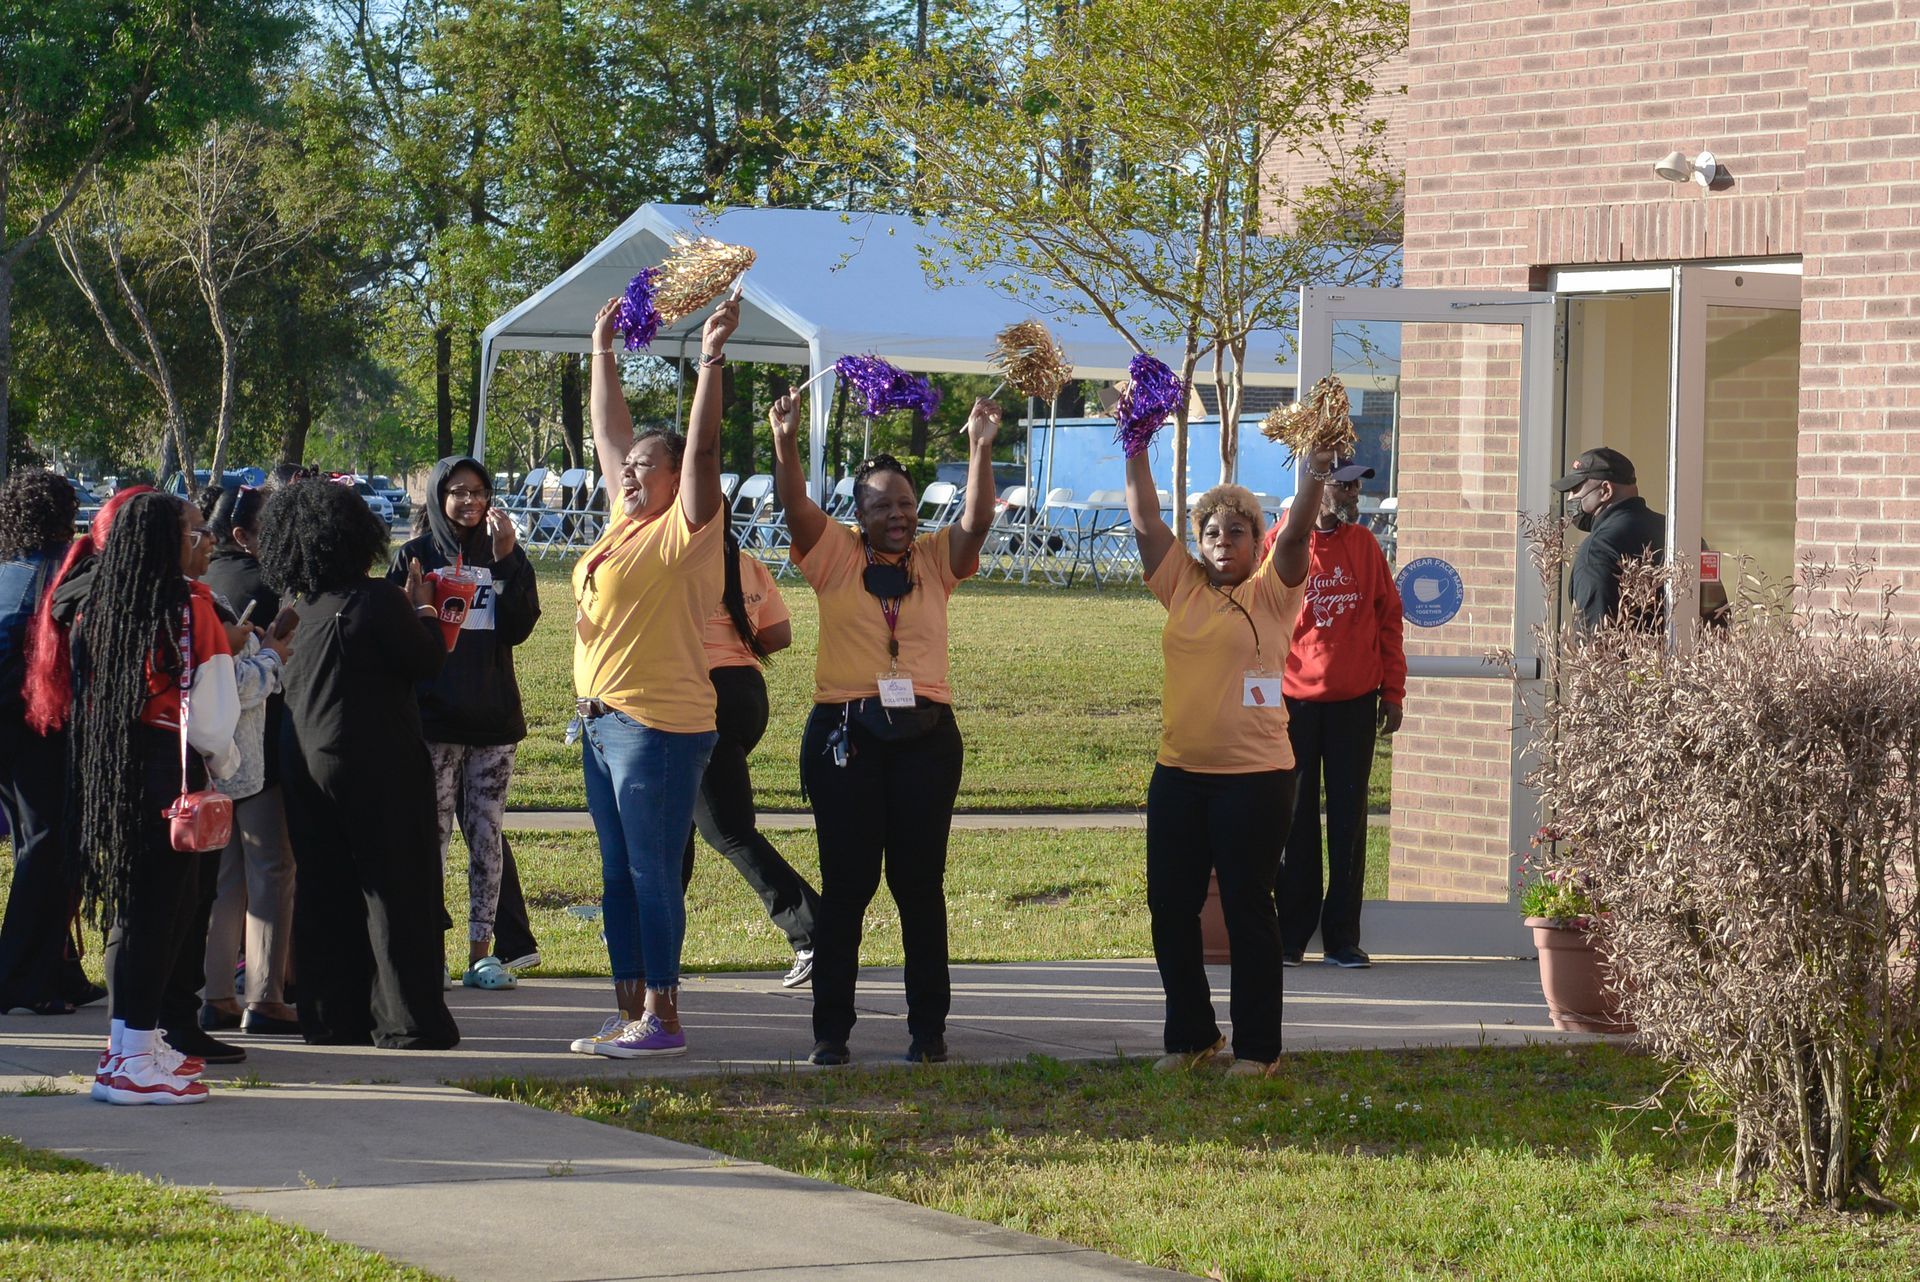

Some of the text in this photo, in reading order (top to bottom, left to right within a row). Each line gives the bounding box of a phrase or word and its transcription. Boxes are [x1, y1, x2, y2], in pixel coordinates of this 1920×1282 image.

[1307, 573, 1340, 590] Have
[1408, 559, 1433, 571] WEAR
[1435, 560, 1455, 575] FACE
[1453, 575, 1463, 600] MASK
[1405, 612, 1422, 625] SOCIAL
